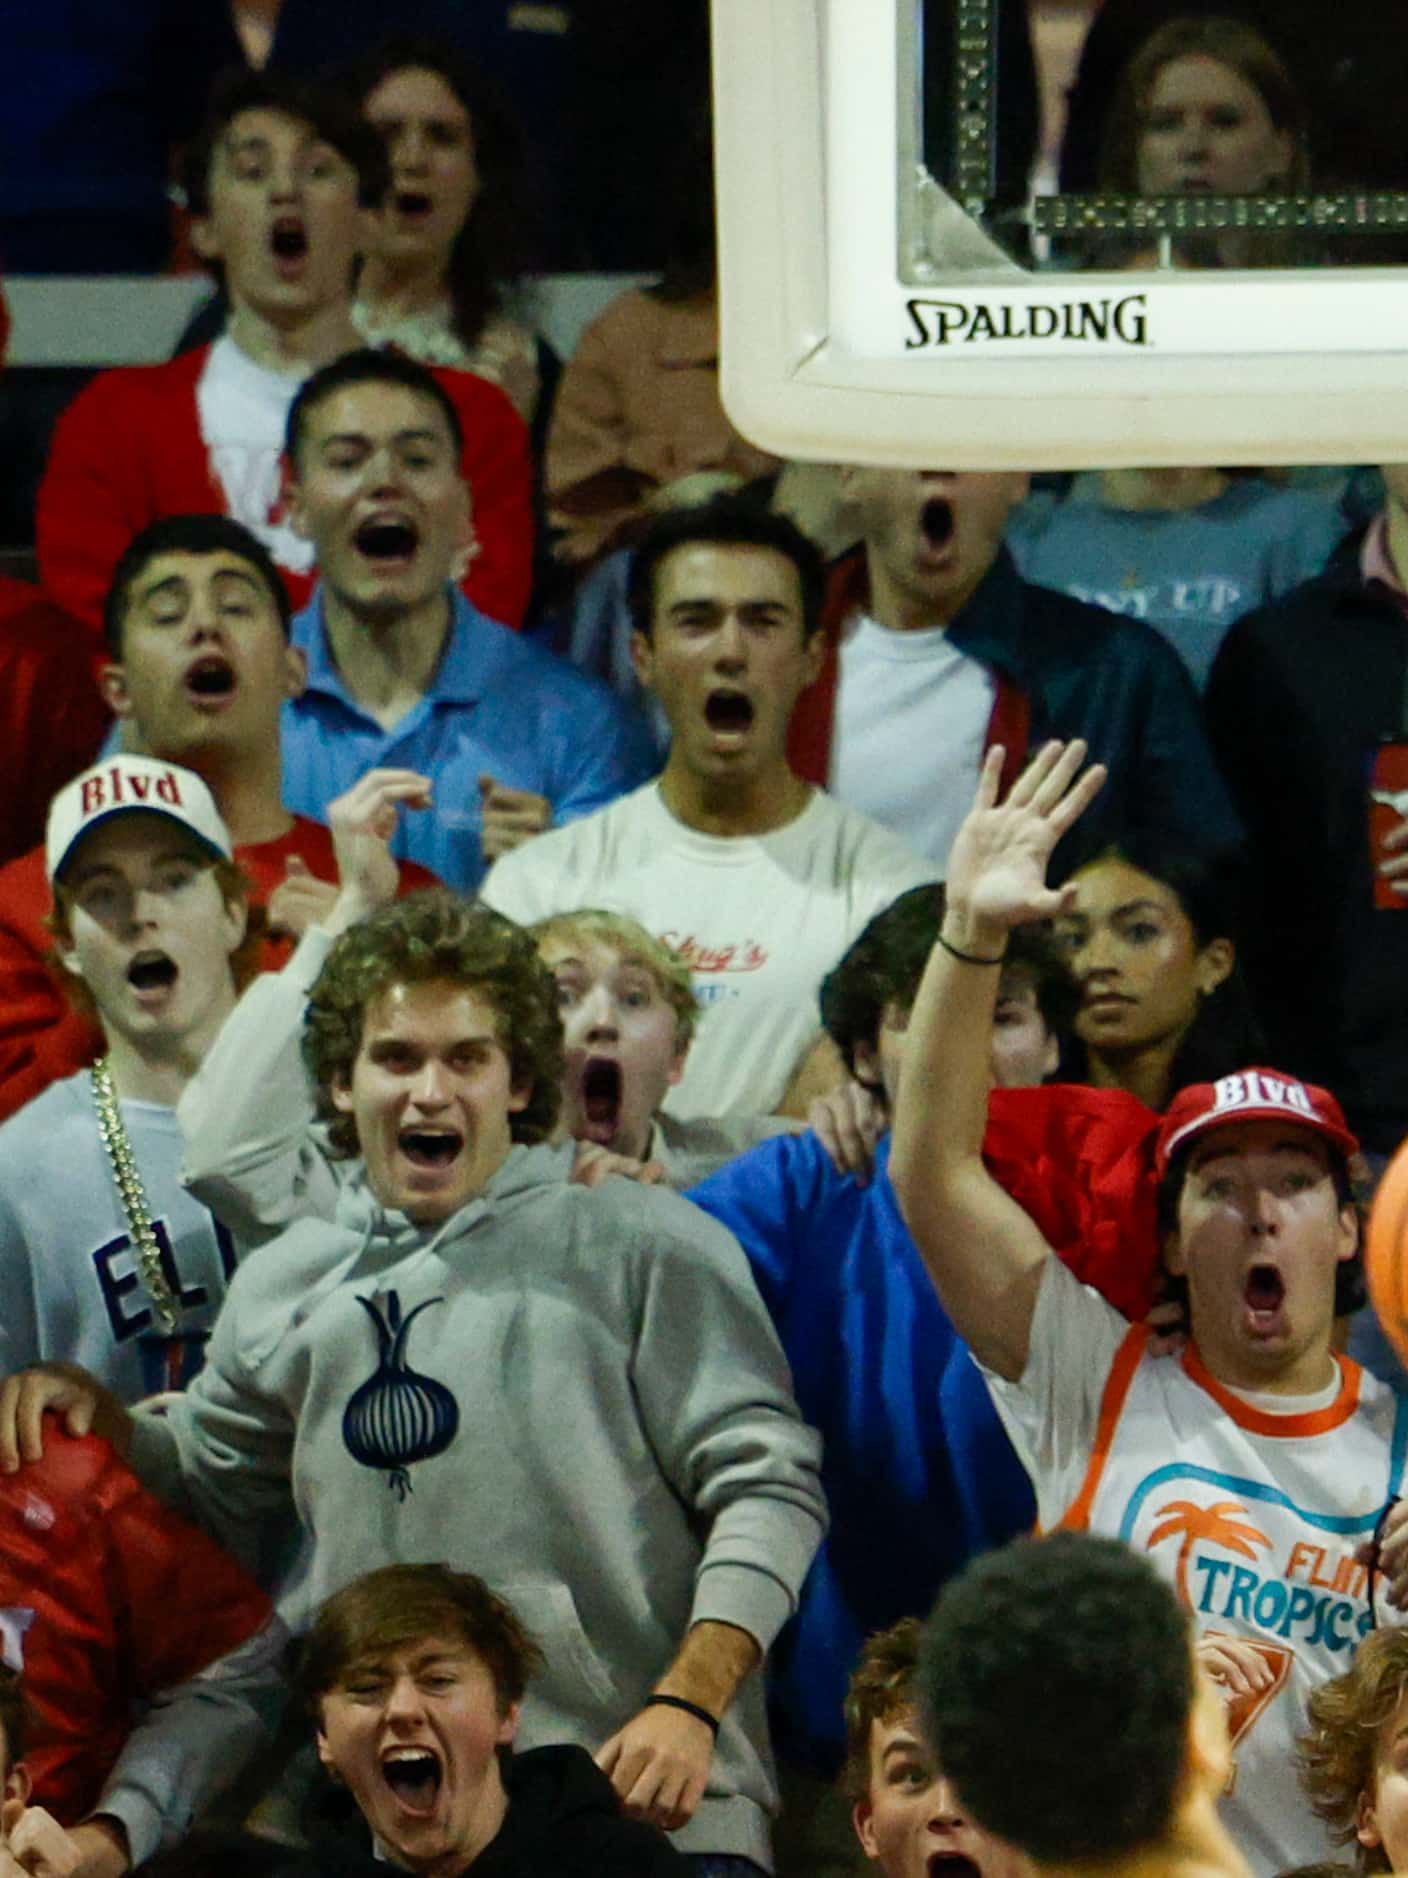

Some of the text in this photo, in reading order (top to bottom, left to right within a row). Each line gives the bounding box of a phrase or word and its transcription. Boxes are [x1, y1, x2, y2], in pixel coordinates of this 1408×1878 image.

[904, 294, 1148, 350] SPALDING
[82, 768, 182, 815] Blvd
[1213, 1070, 1313, 1112] Blvd
